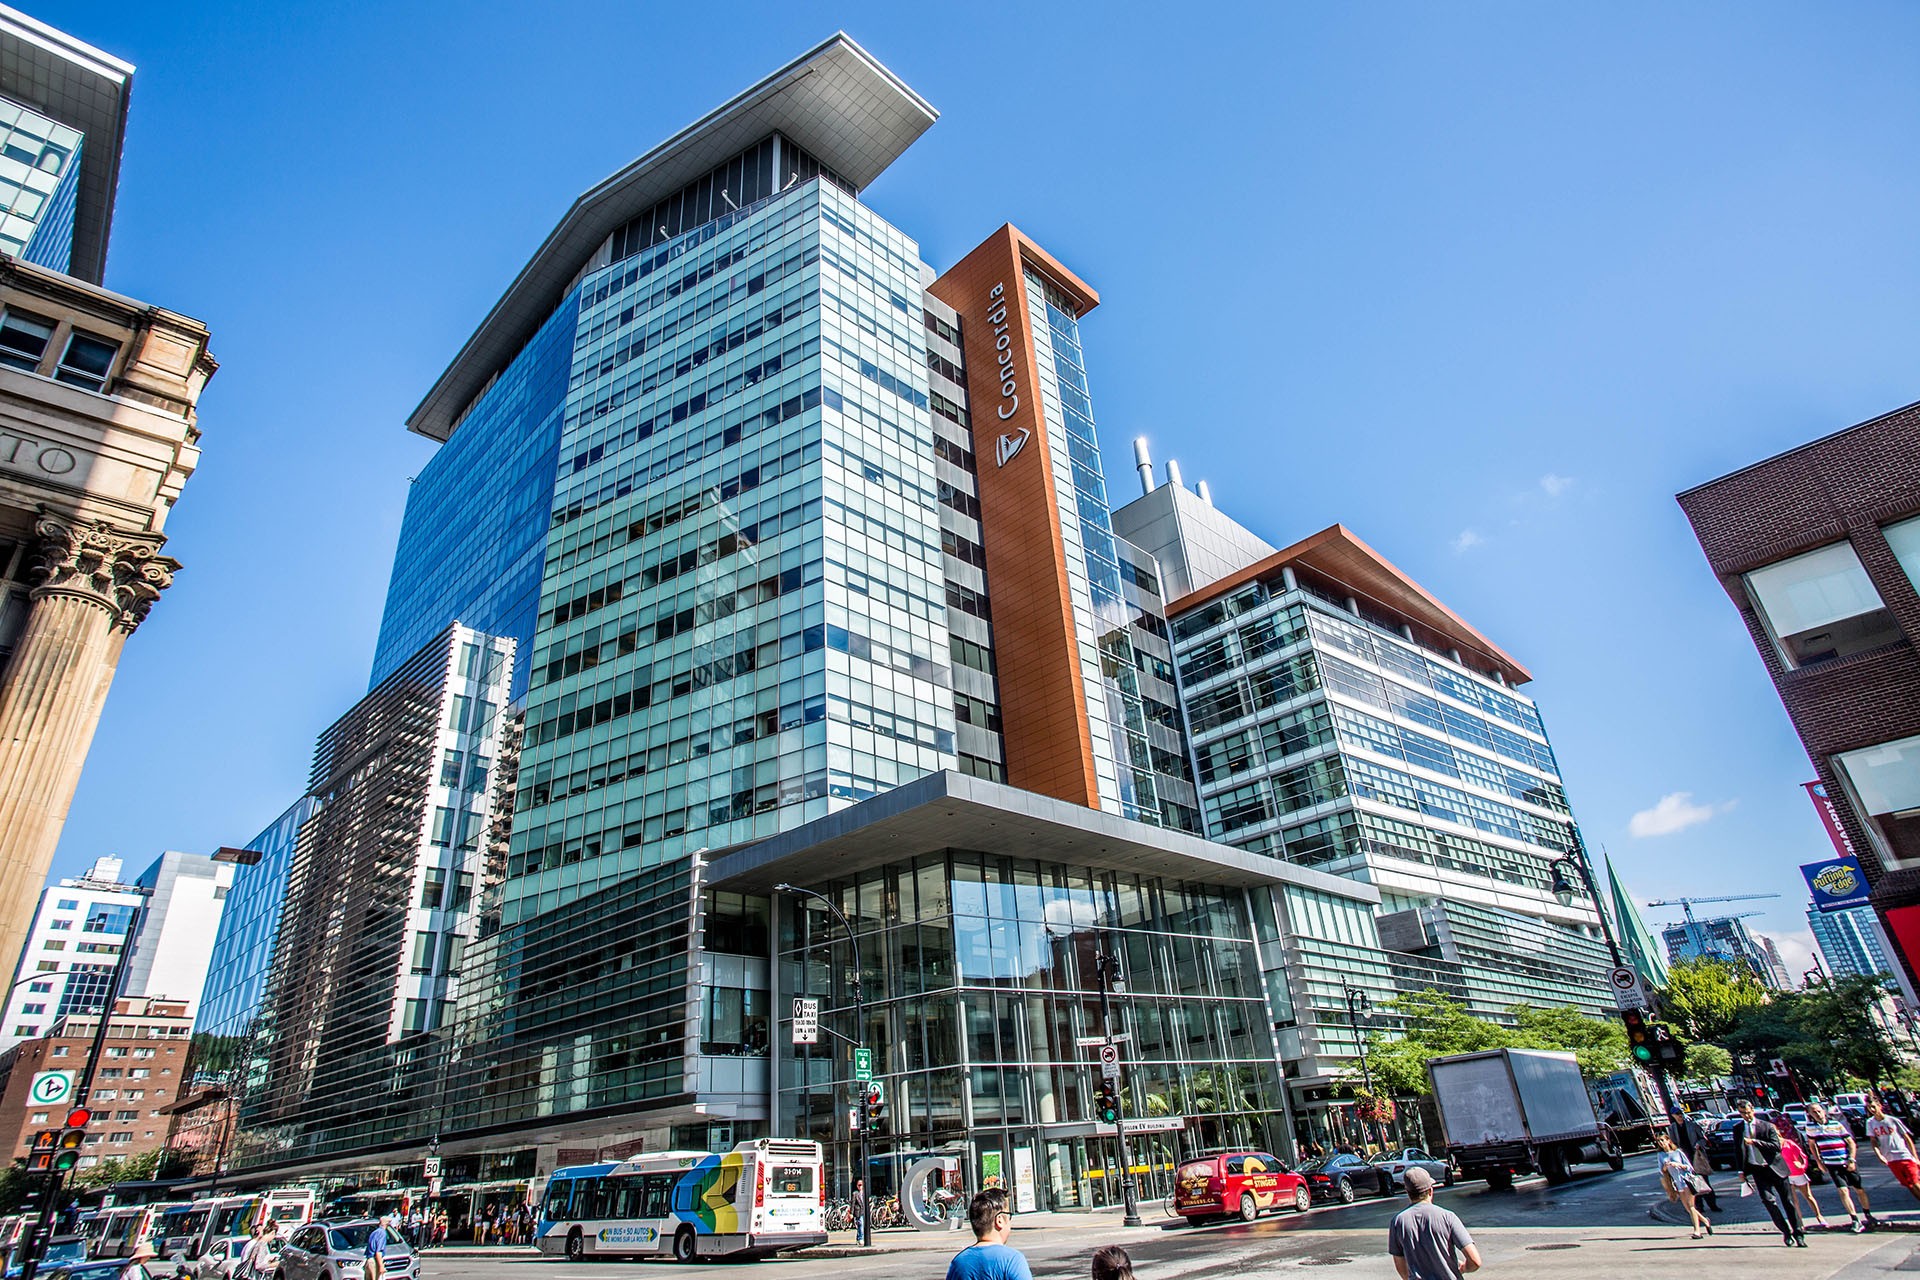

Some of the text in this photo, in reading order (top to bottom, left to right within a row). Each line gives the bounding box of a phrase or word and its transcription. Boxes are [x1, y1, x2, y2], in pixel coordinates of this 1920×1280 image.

[987, 282, 1019, 421] Concordia
[1813, 868, 1846, 889] Putting
[1832, 877, 1854, 891] Edge
[427, 1163, 438, 1173] 50
[1254, 1177, 1277, 1188] STINGERS
[1183, 1198, 1215, 1206] STINGERS.CA
[626, 1227, 634, 1235] 50
[634, 1227, 649, 1235] AUTOS
